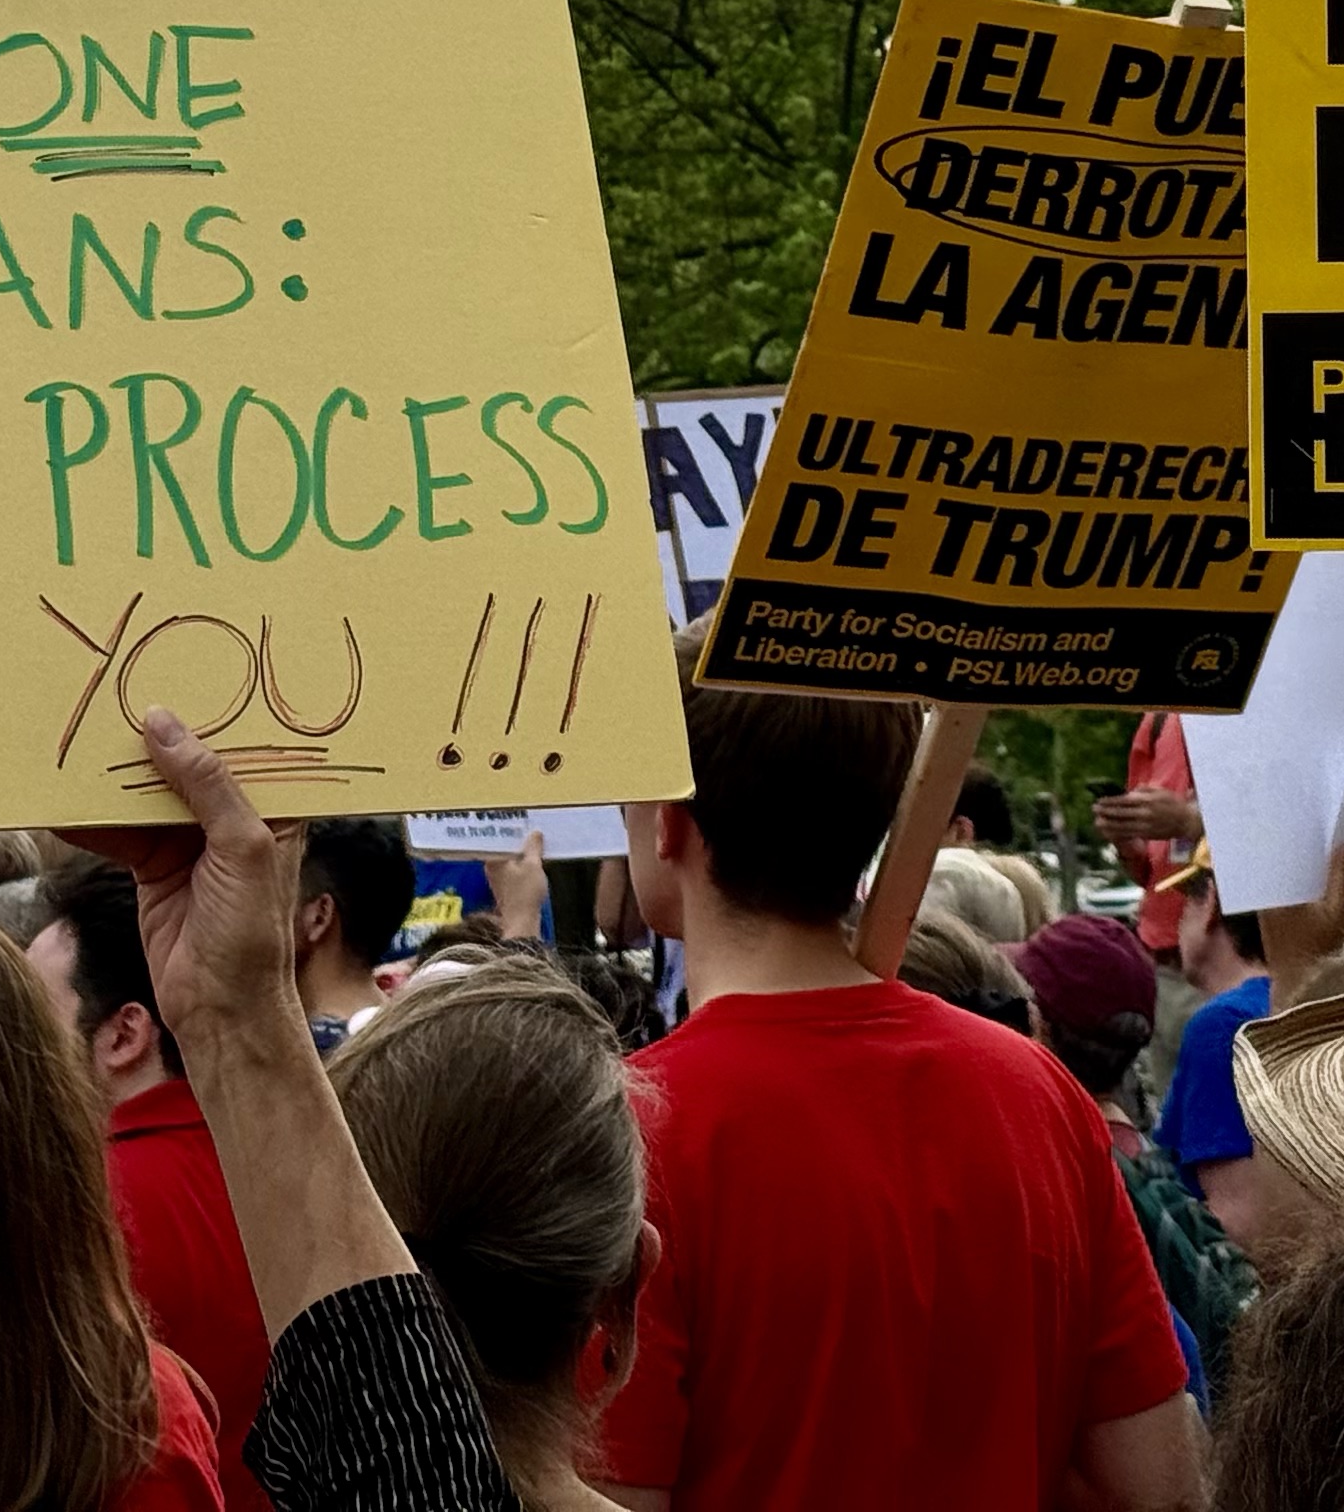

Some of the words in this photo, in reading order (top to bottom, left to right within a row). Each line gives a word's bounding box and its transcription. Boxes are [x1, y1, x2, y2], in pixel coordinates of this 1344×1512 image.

[918, 22, 1065, 120] ¡EL
[848, 231, 971, 330] LA
[988, 255, 1248, 349] AGEN
[25, 371, 613, 570] PROCESS
[765, 482, 909, 570] DE
[929, 498, 1268, 593] TRUMP!
[38, 590, 363, 770] YOU
[436, 590, 603, 774] !!!
[735, 636, 898, 673] Liberation
[948, 657, 1140, 692] PSLWeb.org
[746, 600, 835, 636] Party
[839, 607, 887, 636] for
[891, 612, 1049, 652] Socialism
[1053, 628, 1114, 653] and
